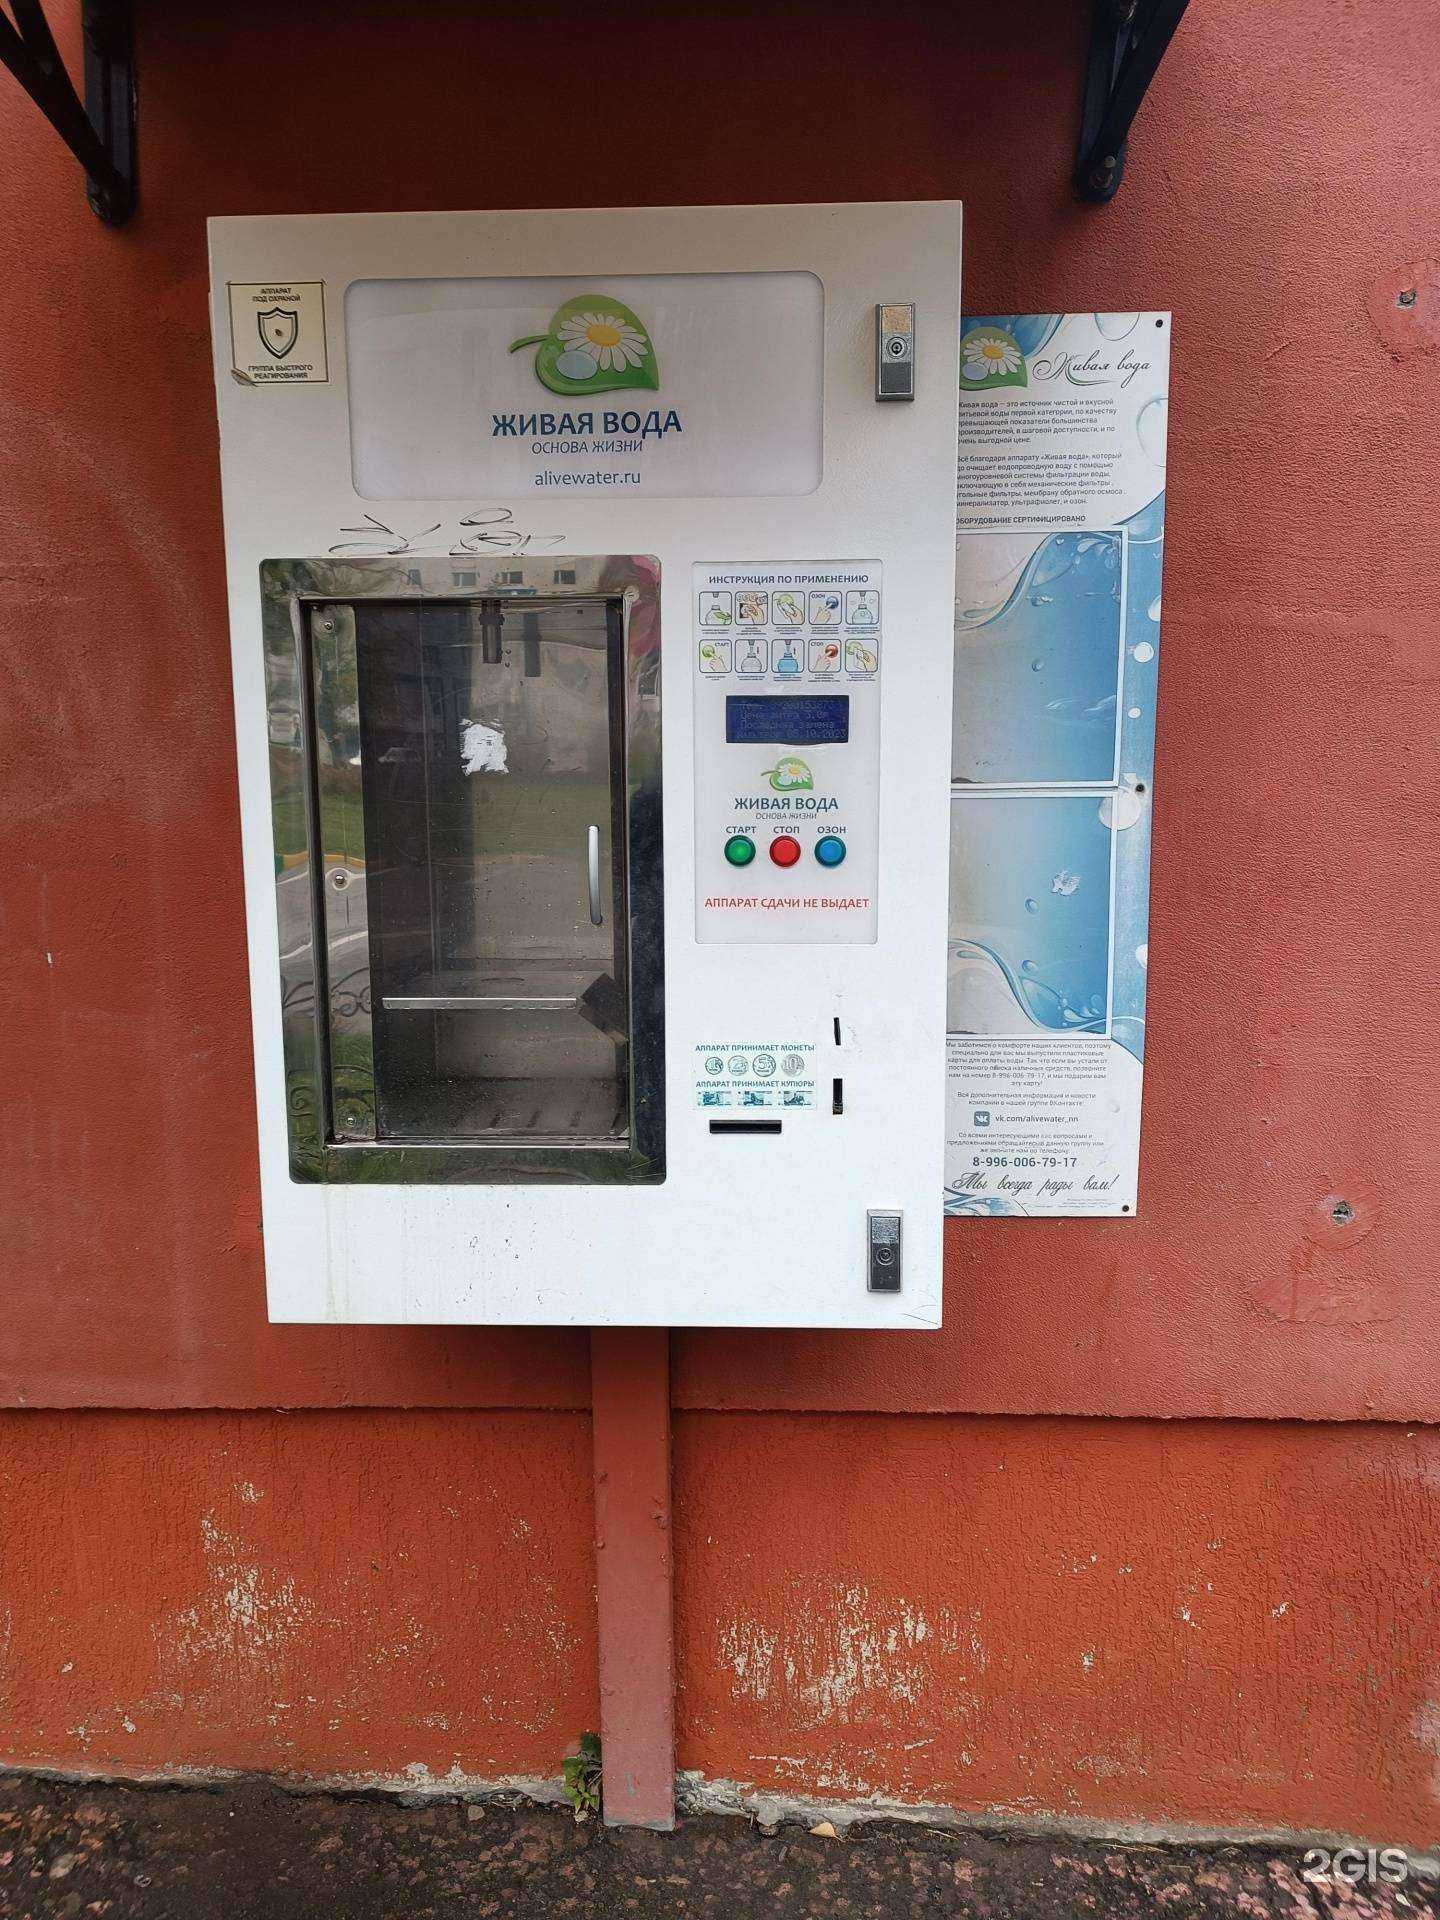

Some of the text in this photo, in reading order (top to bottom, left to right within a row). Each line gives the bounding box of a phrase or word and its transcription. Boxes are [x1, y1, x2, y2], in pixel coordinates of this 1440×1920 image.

[1117, 349, 1151, 388] вода
[492, 410, 682, 439] ЖИВАЯ ВОДА
[532, 440, 643, 454] ОСНОВА ЖИЗНИ
[534, 471, 641, 486] alivewater.ru
[1013, 515, 1086, 523] СЕРТИФИЦИРОВАНО
[709, 575, 869, 585] ИНСТРУКЦИЯ ПО ПРИМЕНЕНИЮ
[734, 797, 839, 812] ЖИВАЯ ВОДА
[755, 812, 817, 820] ОСНОВА ЖИЗНИ
[725, 826, 847, 834] СТАРТ СТОП ОЗОН
[704, 898, 870, 910] АППАРАТ СДАЧИ НЕ ВЫДАЕТ
[995, 1114, 1079, 1123] vk.com/alivewater_nn
[973, 1157, 1077, 1167] 8-996-006-79-17
[952, 1171, 1120, 1196] Мы всегда рады вам!
